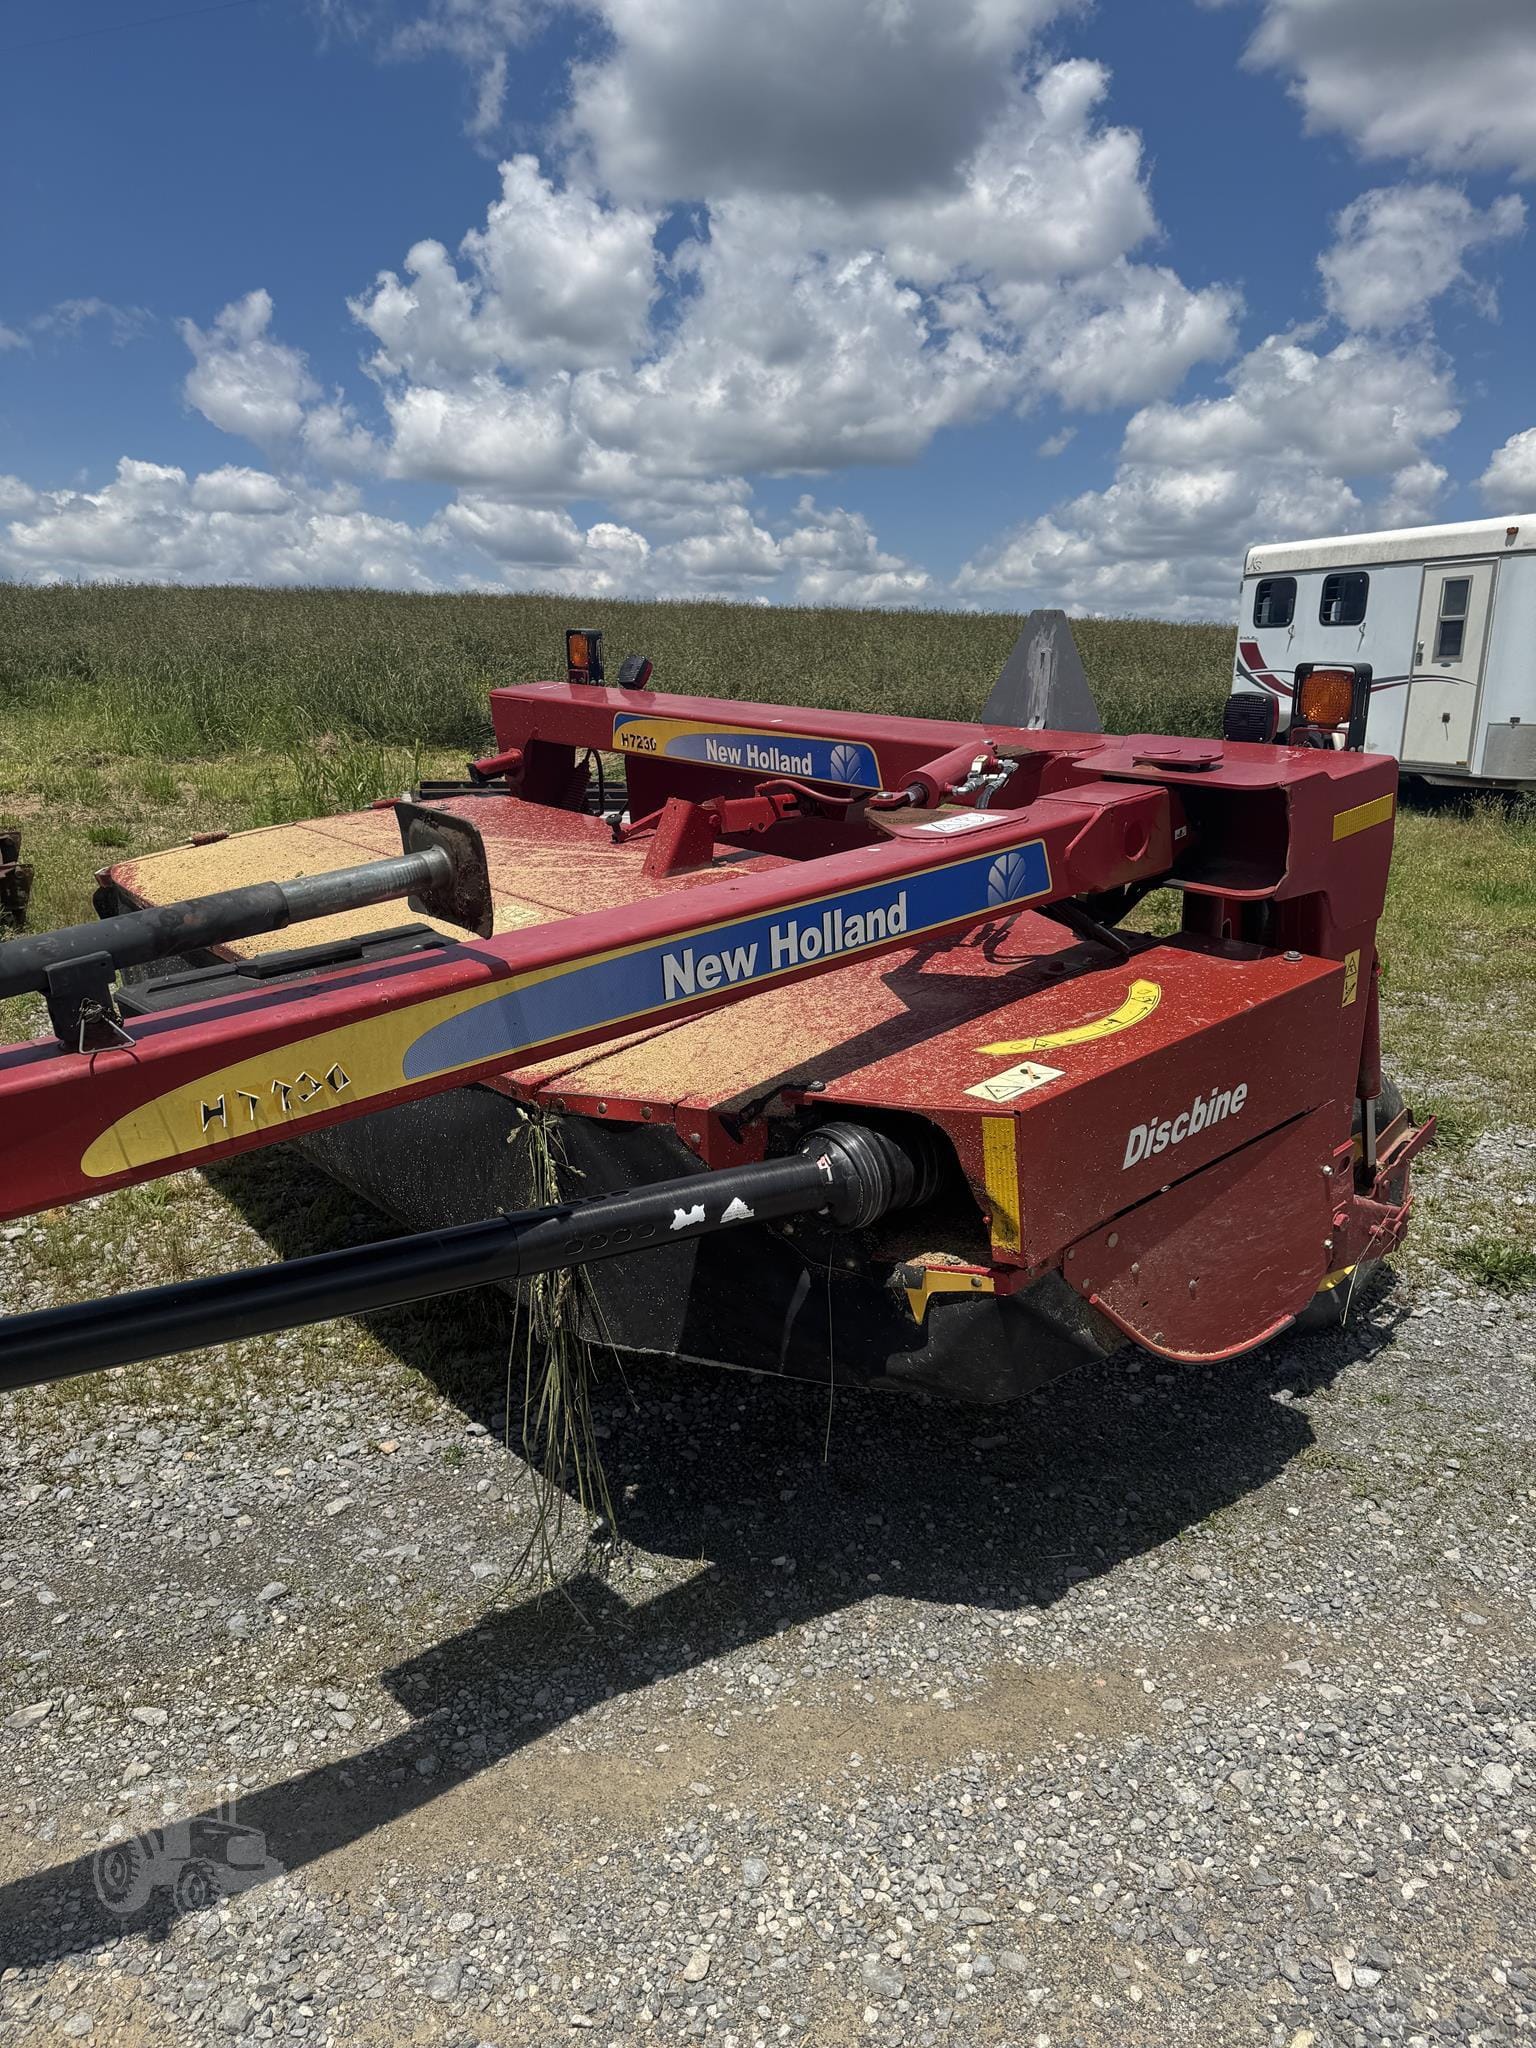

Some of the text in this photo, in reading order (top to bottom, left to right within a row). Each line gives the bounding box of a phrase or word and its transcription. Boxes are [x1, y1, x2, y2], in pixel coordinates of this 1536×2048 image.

[621, 733, 657, 751] H7230
[705, 738, 813, 776] New Holland
[662, 891, 908, 1001] New Holland
[1122, 1082, 1249, 1171] Discbine
